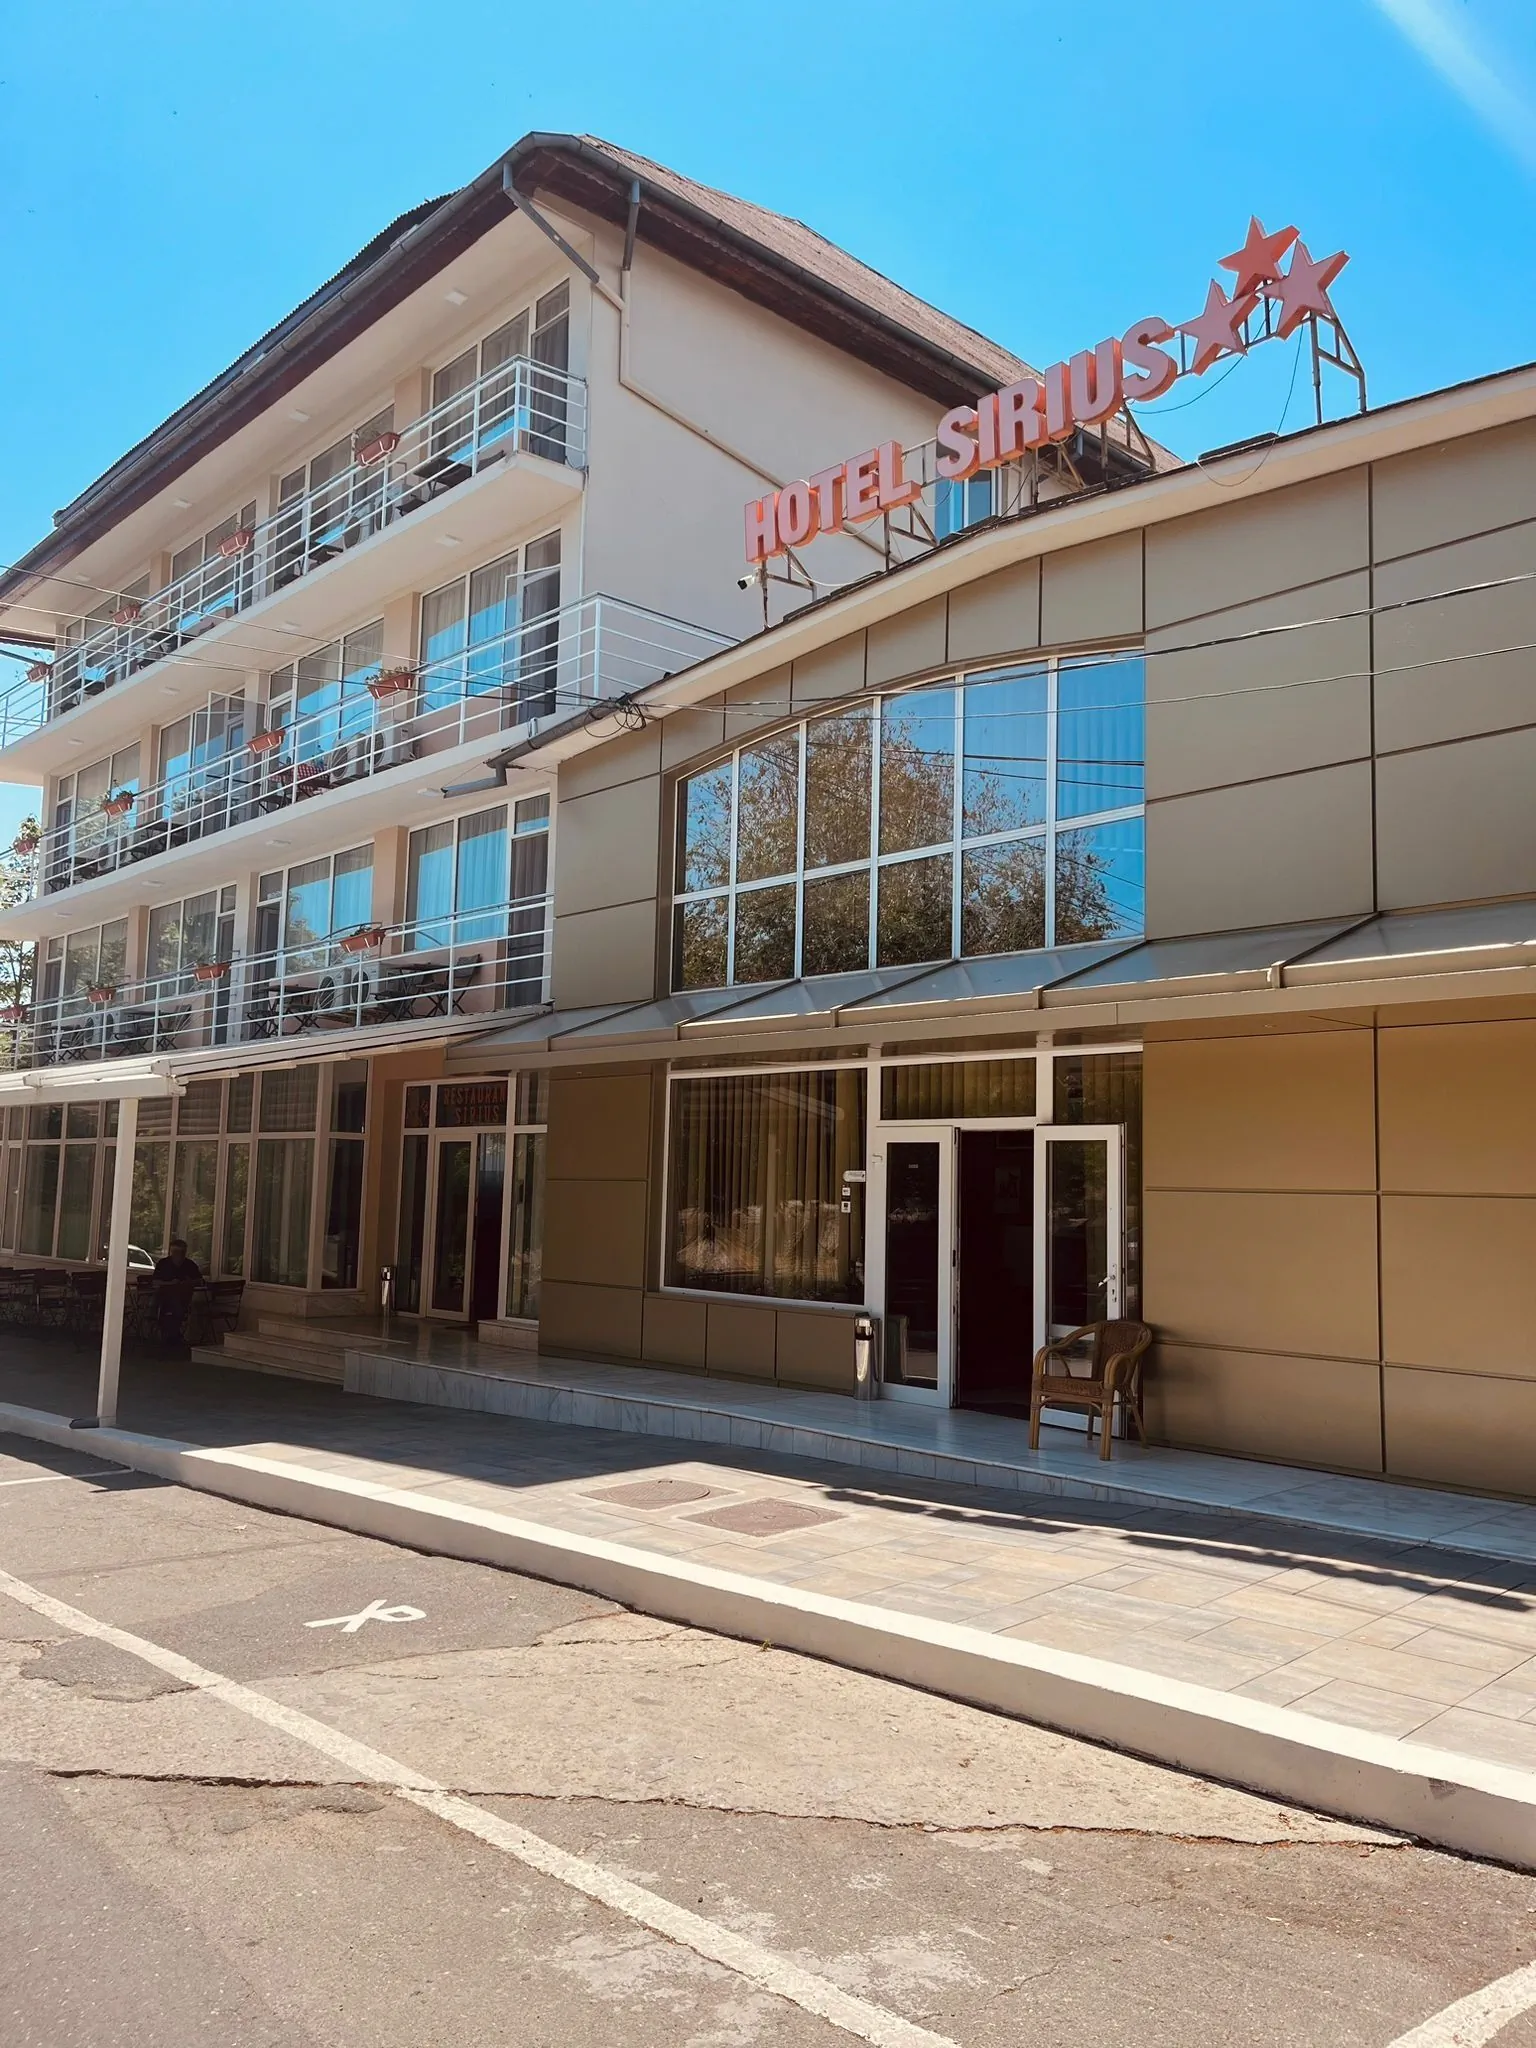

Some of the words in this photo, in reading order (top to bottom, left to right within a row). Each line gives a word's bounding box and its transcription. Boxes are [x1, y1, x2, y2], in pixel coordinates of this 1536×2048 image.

[744, 440, 922, 563] HOTEL
[936, 316, 1176, 481] SIRIUS
[444, 1085, 507, 1105] RESTAURAN
[454, 1105, 500, 1125] SIRIUS
